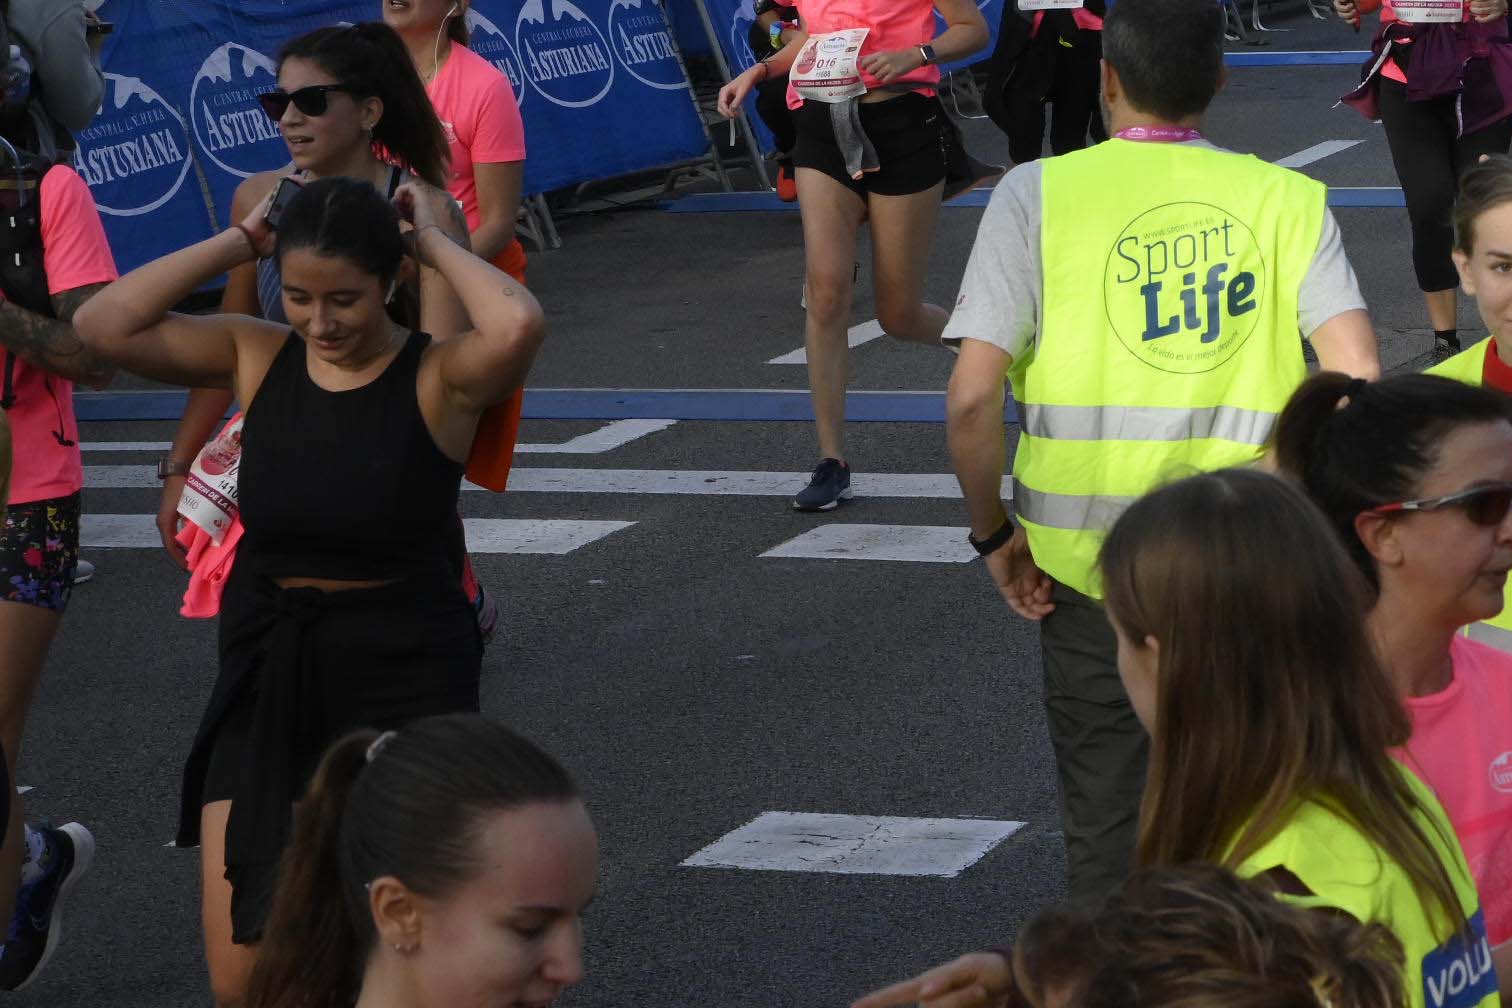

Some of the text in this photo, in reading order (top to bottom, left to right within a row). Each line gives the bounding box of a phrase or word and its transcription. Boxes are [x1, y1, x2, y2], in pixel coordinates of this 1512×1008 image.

[525, 39, 609, 82] ASTURIANA
[817, 58, 837, 68] 016
[1117, 219, 1235, 284] Sport
[1140, 262, 1256, 343] Life
[209, 492, 219, 500] DE
